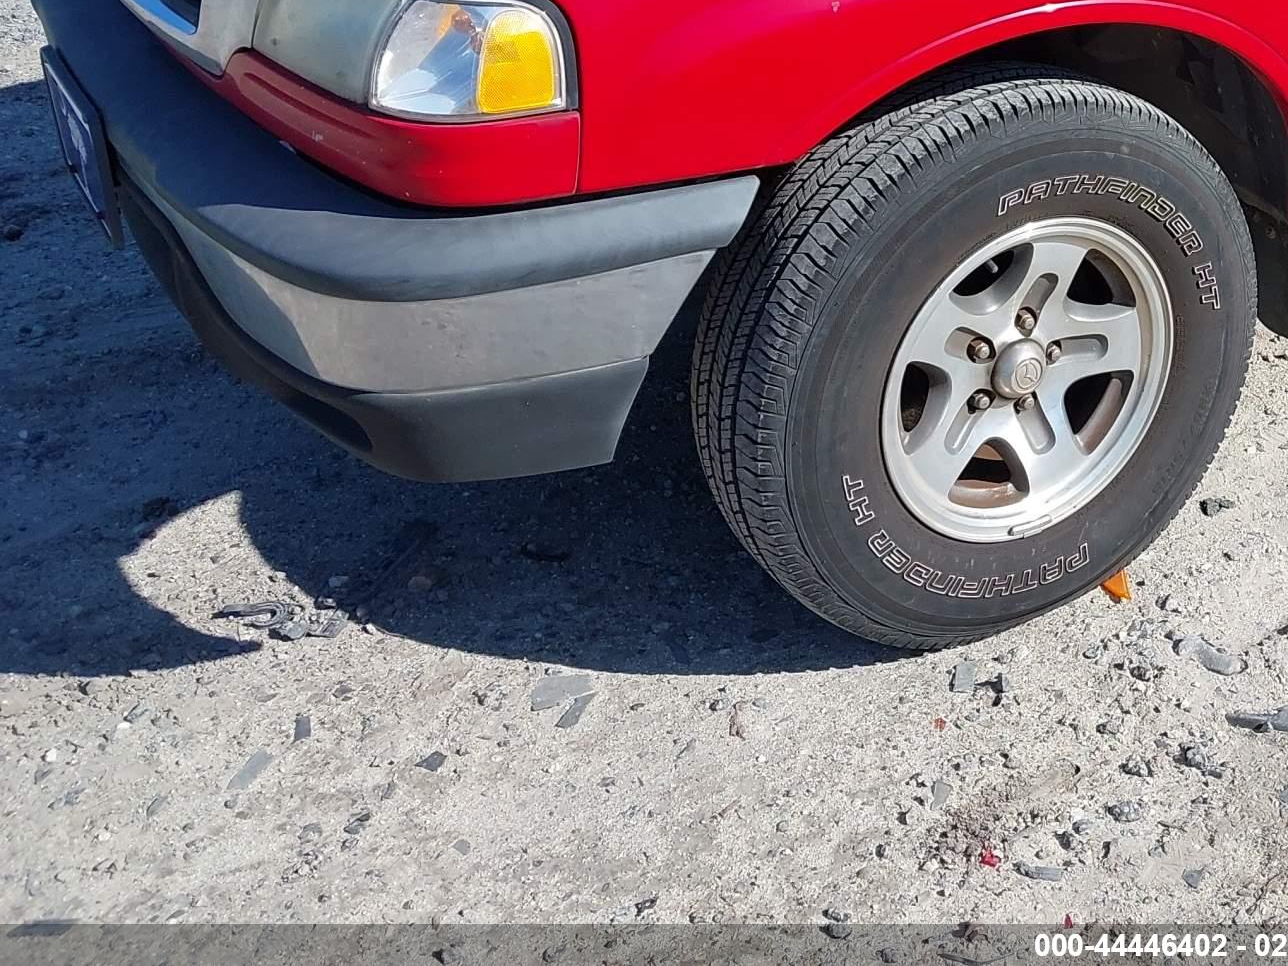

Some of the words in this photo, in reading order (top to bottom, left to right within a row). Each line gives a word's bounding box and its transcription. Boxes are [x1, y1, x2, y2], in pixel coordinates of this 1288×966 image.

[998, 174, 1204, 257] PATHFINDER
[1194, 260, 1221, 310] HT
[842, 475, 875, 526] HT
[868, 529, 1090, 598] PATHFINDER
